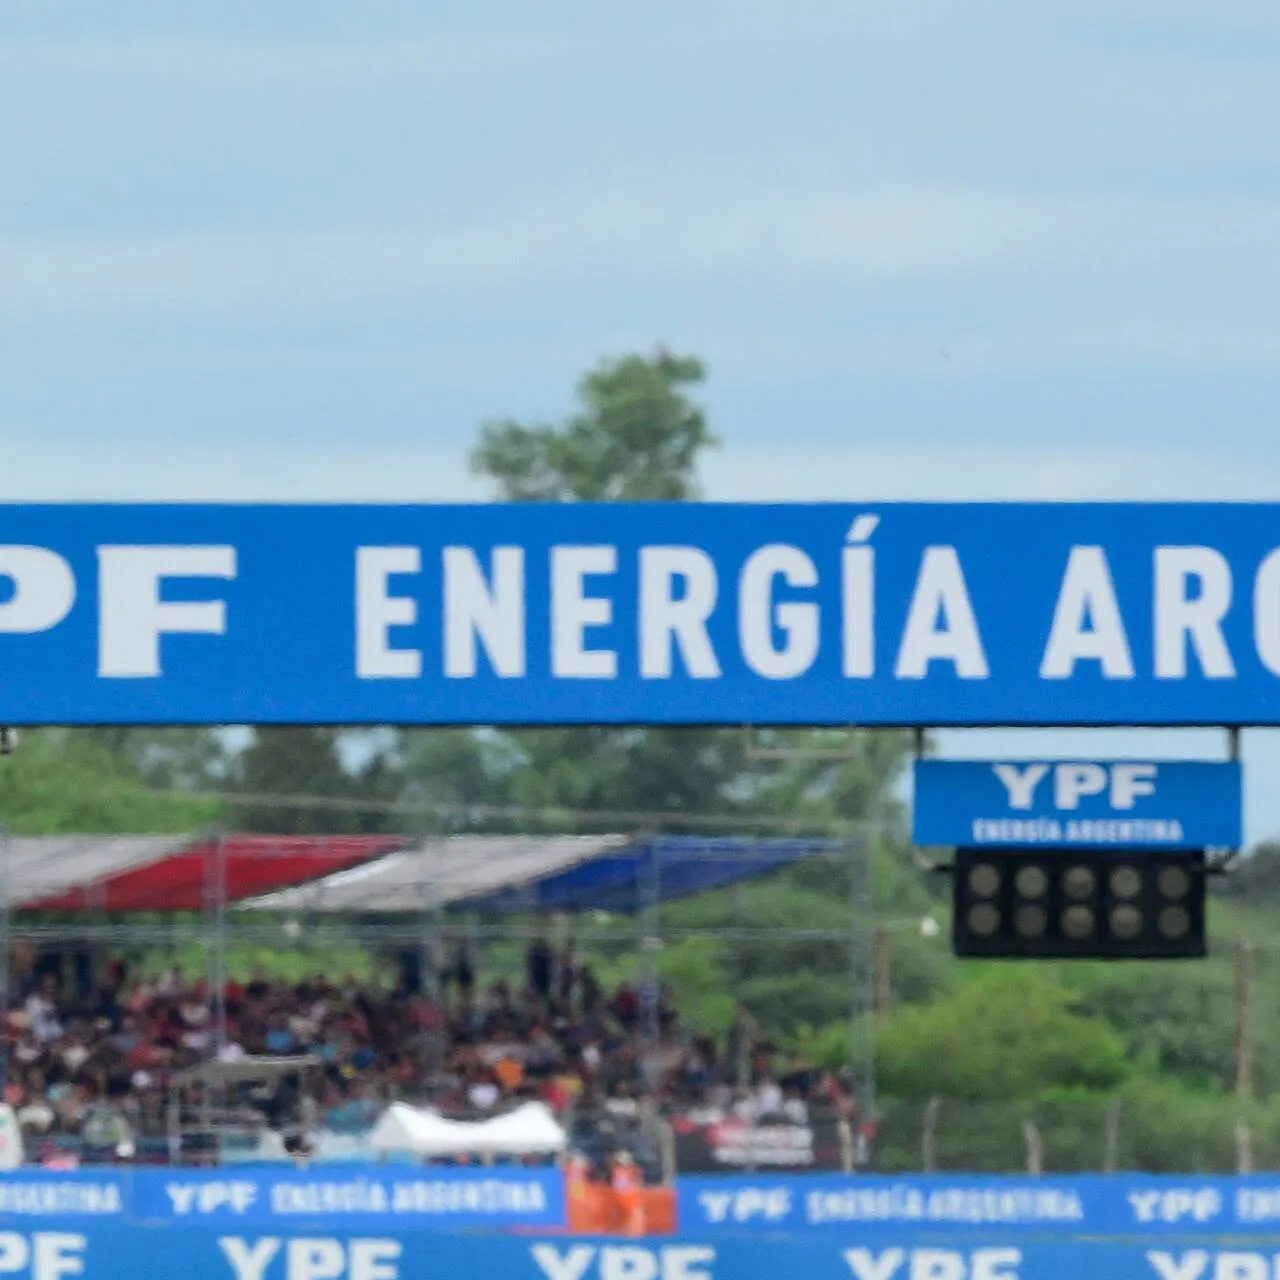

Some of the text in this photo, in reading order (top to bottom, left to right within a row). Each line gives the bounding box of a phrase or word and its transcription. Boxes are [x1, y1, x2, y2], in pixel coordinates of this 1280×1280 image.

[355, 514, 991, 679] ENERGÍA
[991, 763, 1158, 810] YPF
[166, 1180, 259, 1214] YPF
[698, 1186, 791, 1222] YPF
[1128, 1186, 1223, 1222] YPF
